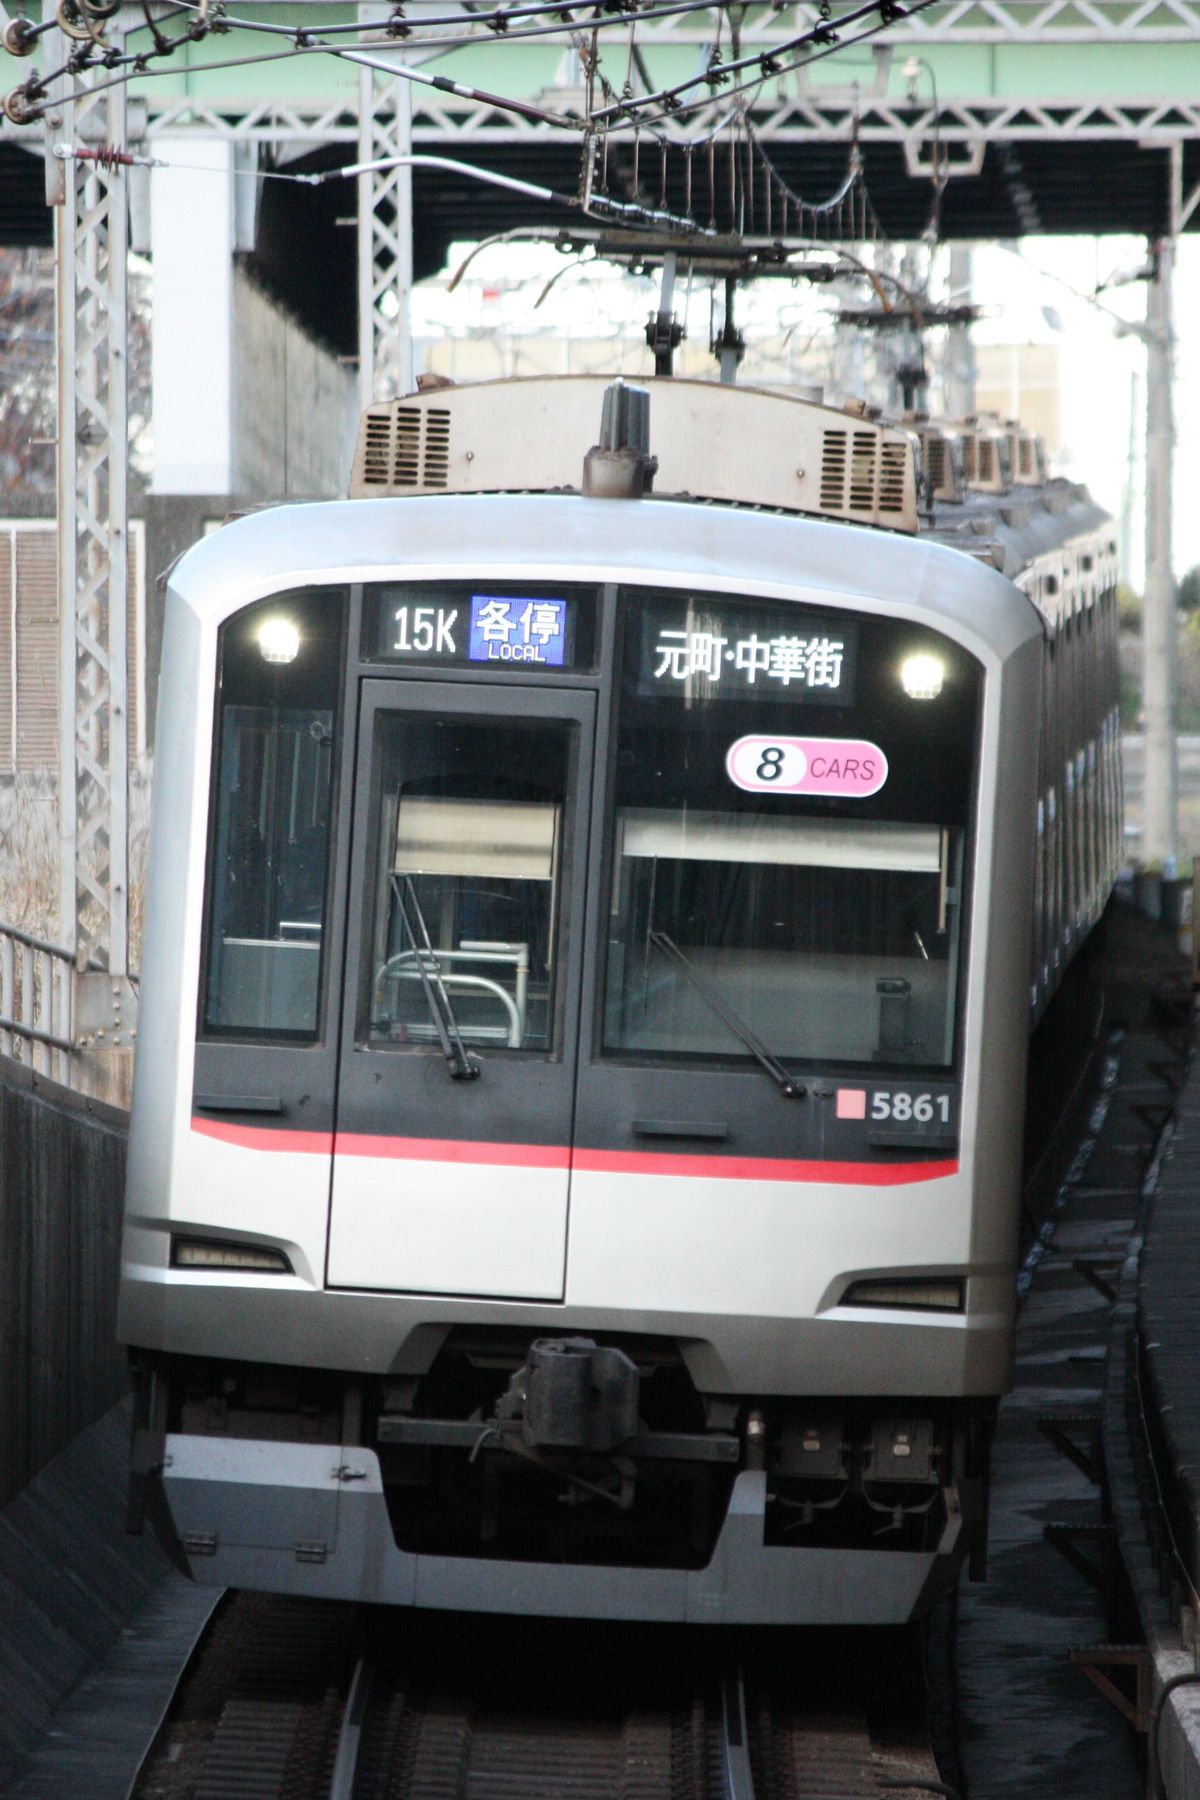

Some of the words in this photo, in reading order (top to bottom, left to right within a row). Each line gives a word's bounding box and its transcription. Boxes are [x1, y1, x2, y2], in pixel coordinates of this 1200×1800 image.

[393, 606, 459, 653] 15K
[476, 600, 561, 644] 各停
[487, 643, 547, 663] LOCAL
[756, 746, 786, 782] 8
[810, 757, 876, 781] CARS
[871, 1091, 950, 1123] 5861
